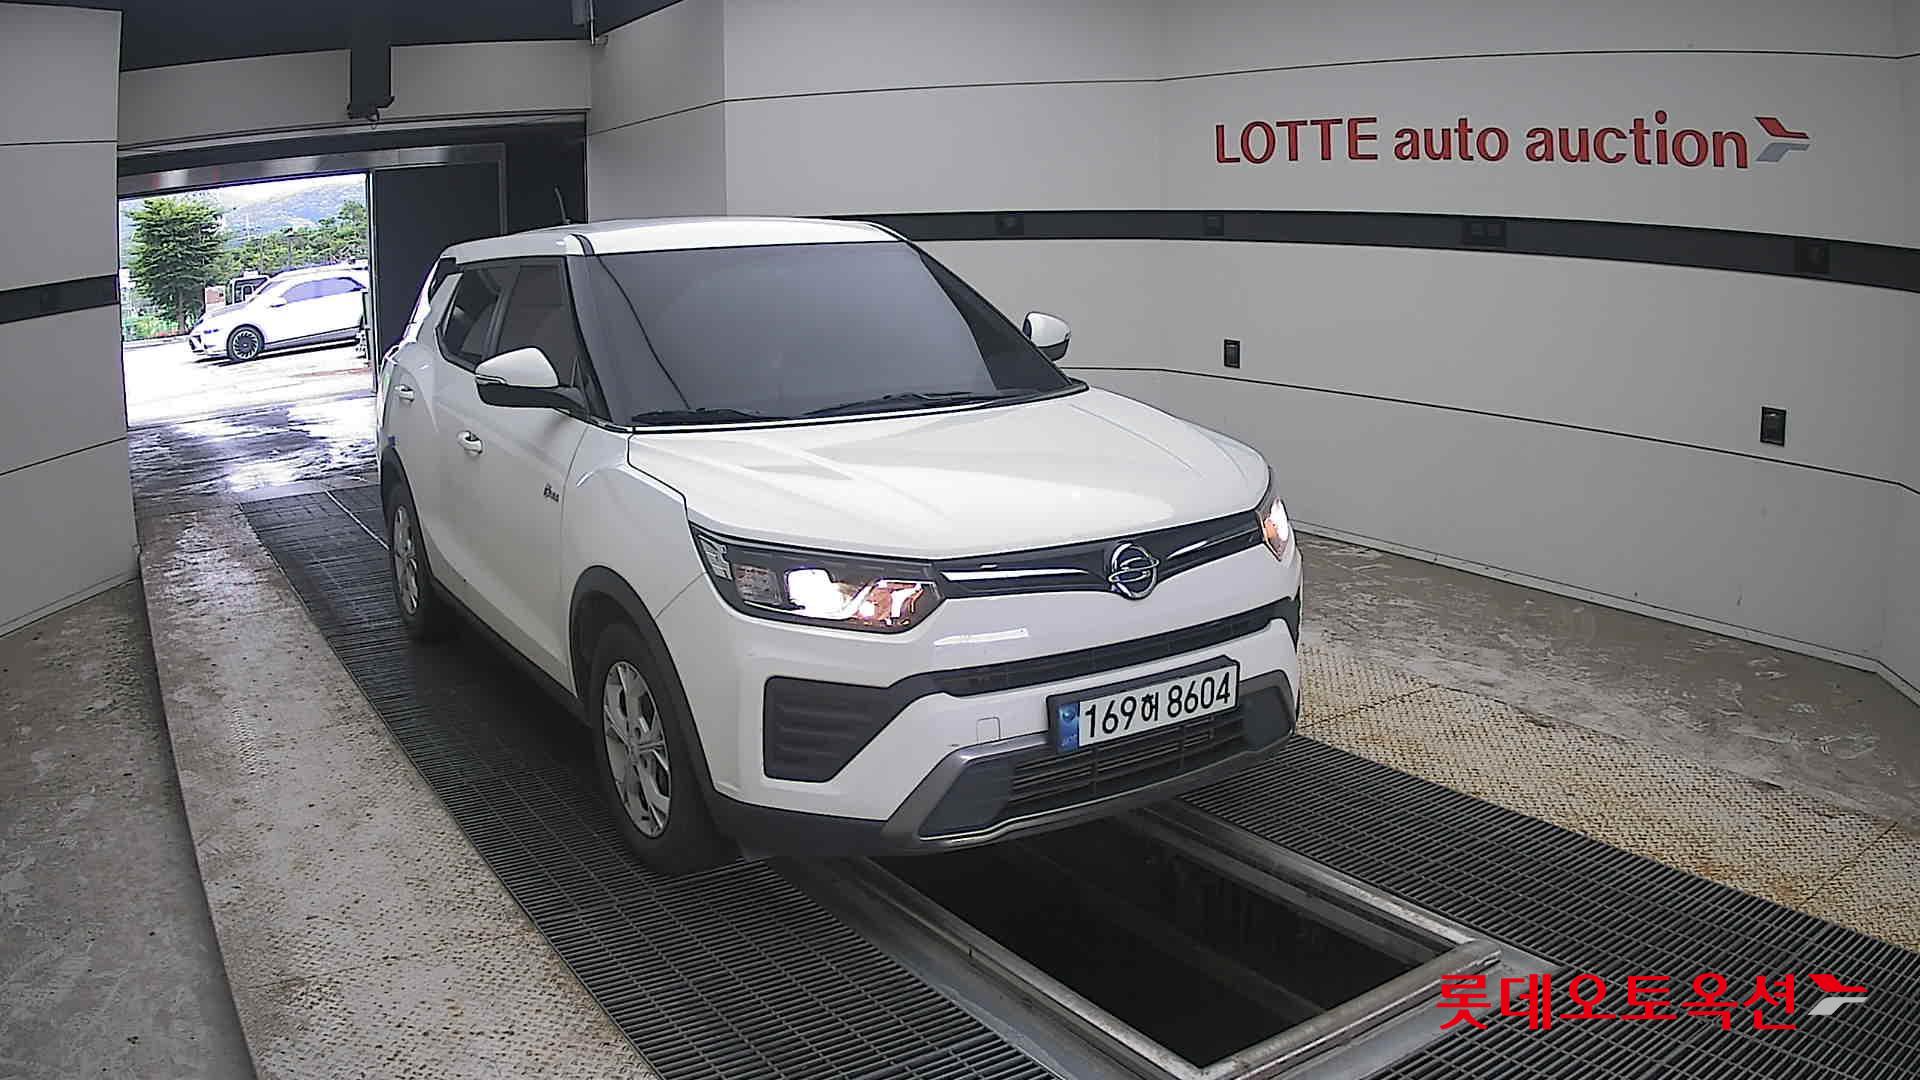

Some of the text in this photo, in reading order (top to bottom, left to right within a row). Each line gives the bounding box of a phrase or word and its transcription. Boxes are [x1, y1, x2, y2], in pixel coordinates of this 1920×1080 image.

[1216, 110, 1750, 169] LOTTE auto auction
[1085, 671, 1231, 739] 169허 8604
